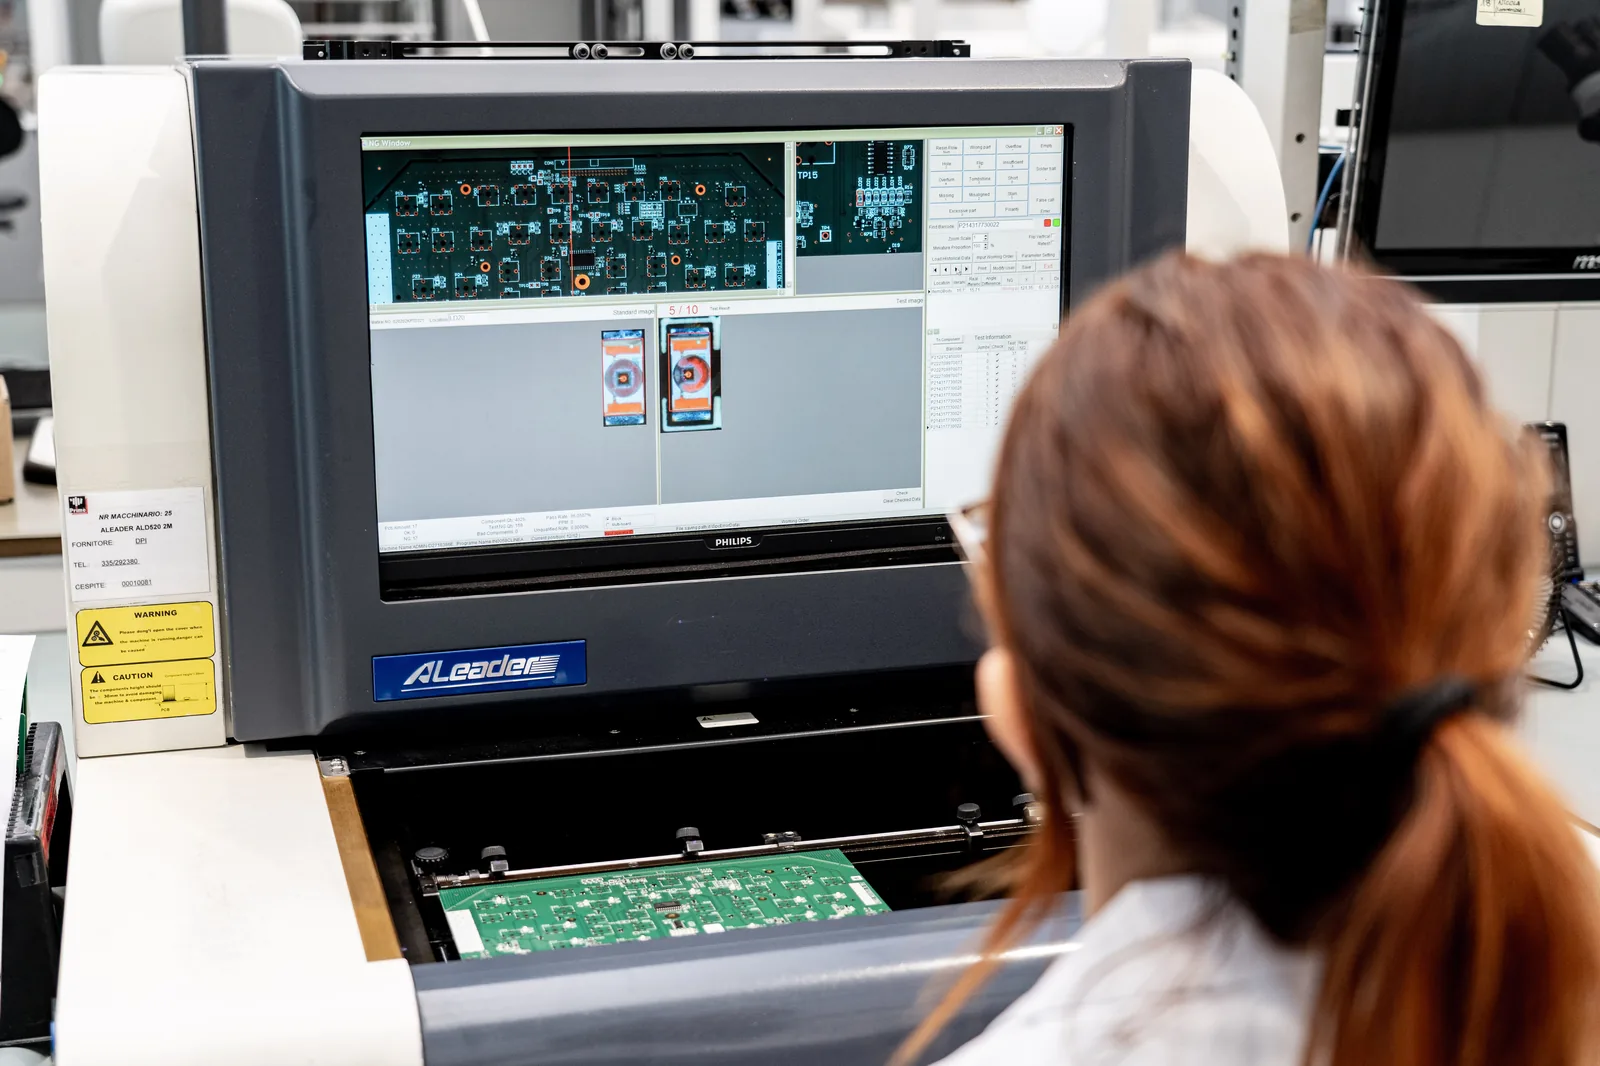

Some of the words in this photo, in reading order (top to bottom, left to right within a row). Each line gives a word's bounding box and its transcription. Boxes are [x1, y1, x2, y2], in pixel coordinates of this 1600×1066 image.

[381, 139, 411, 147] Window
[797, 172, 819, 182] TP15
[669, 305, 676, 315] 5
[678, 305, 683, 315] /
[686, 304, 698, 315] 10
[98, 513, 109, 521] NR
[110, 511, 162, 520] MACCHINARIO:
[100, 525, 134, 534] ALEADER
[135, 523, 161, 532] ALD520
[163, 522, 173, 530] 2M
[134, 537, 148, 545] DPI
[715, 536, 752, 547] PHILIPS
[121, 578, 152, 588] 00010081
[134, 609, 178, 619] WARNING
[112, 672, 153, 681] CAUTION
